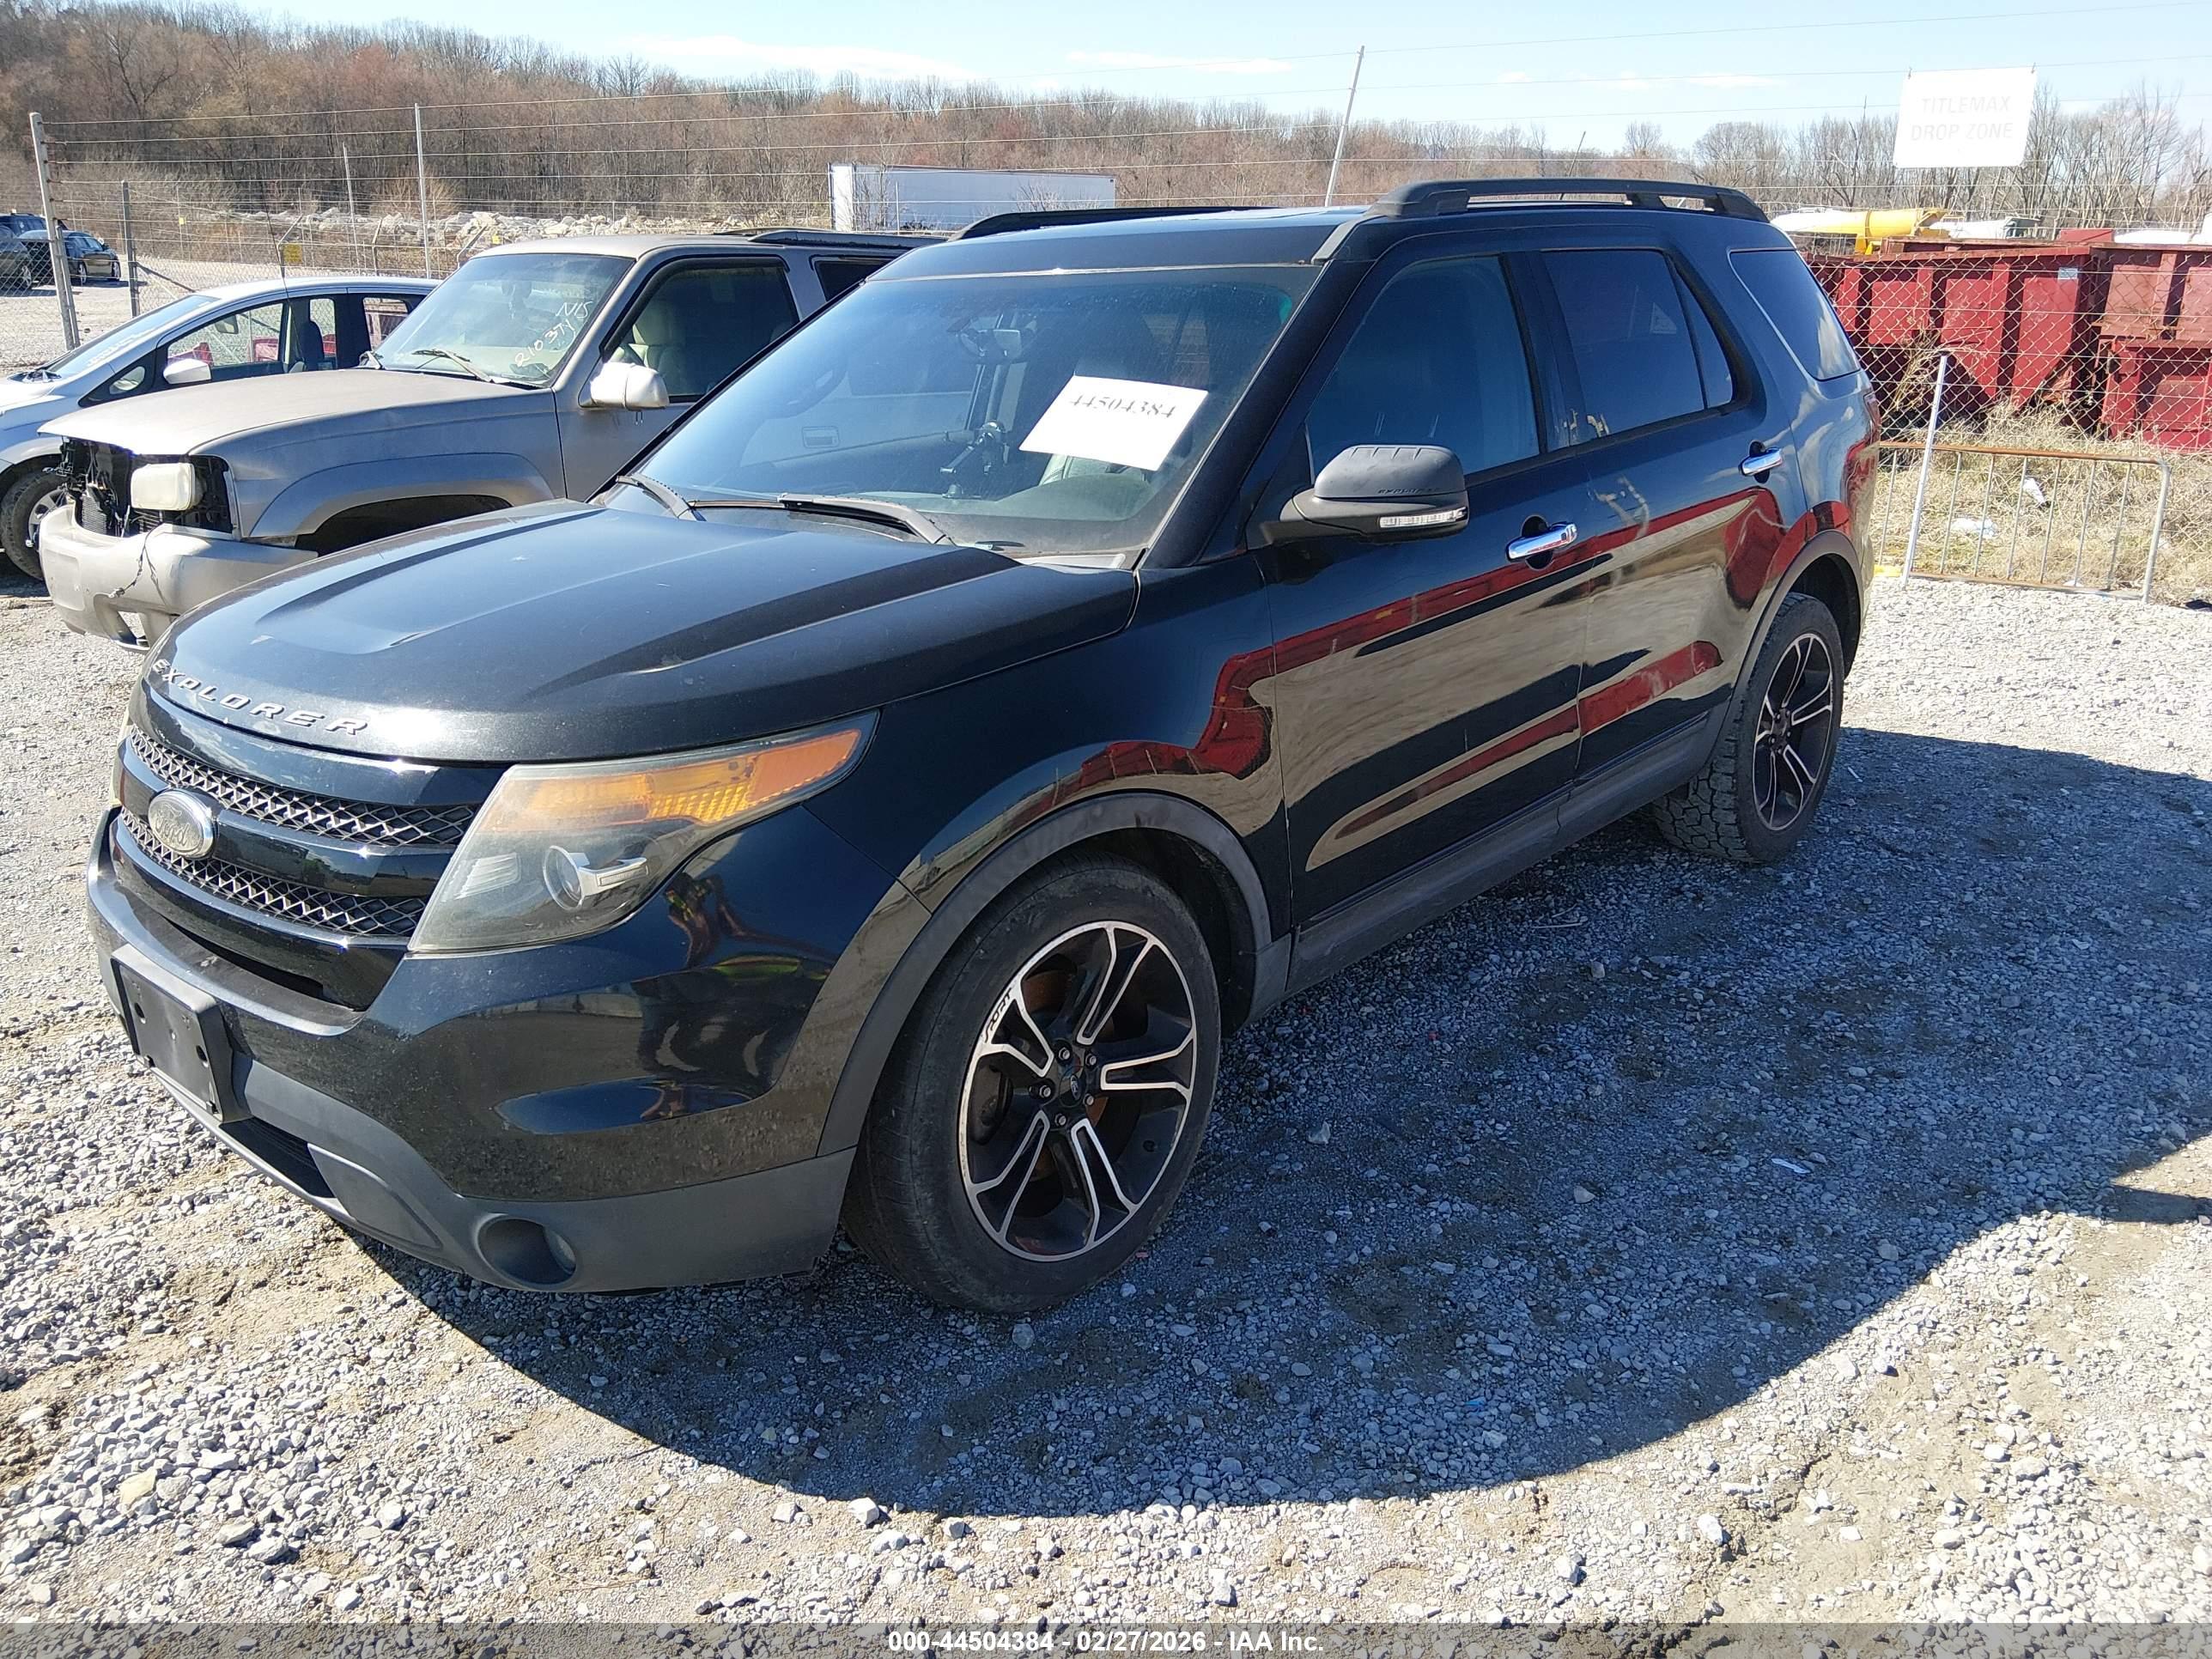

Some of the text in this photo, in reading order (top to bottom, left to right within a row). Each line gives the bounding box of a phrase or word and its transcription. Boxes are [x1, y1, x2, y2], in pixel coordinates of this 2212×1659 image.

[1921, 95, 2012, 114] TITLEMAX
[1911, 122, 2014, 142] DROP ZONE
[1071, 394, 1177, 418] 44504384
[151, 658, 369, 736] EXPLORER
[984, 988, 1012, 1043] SPORT
